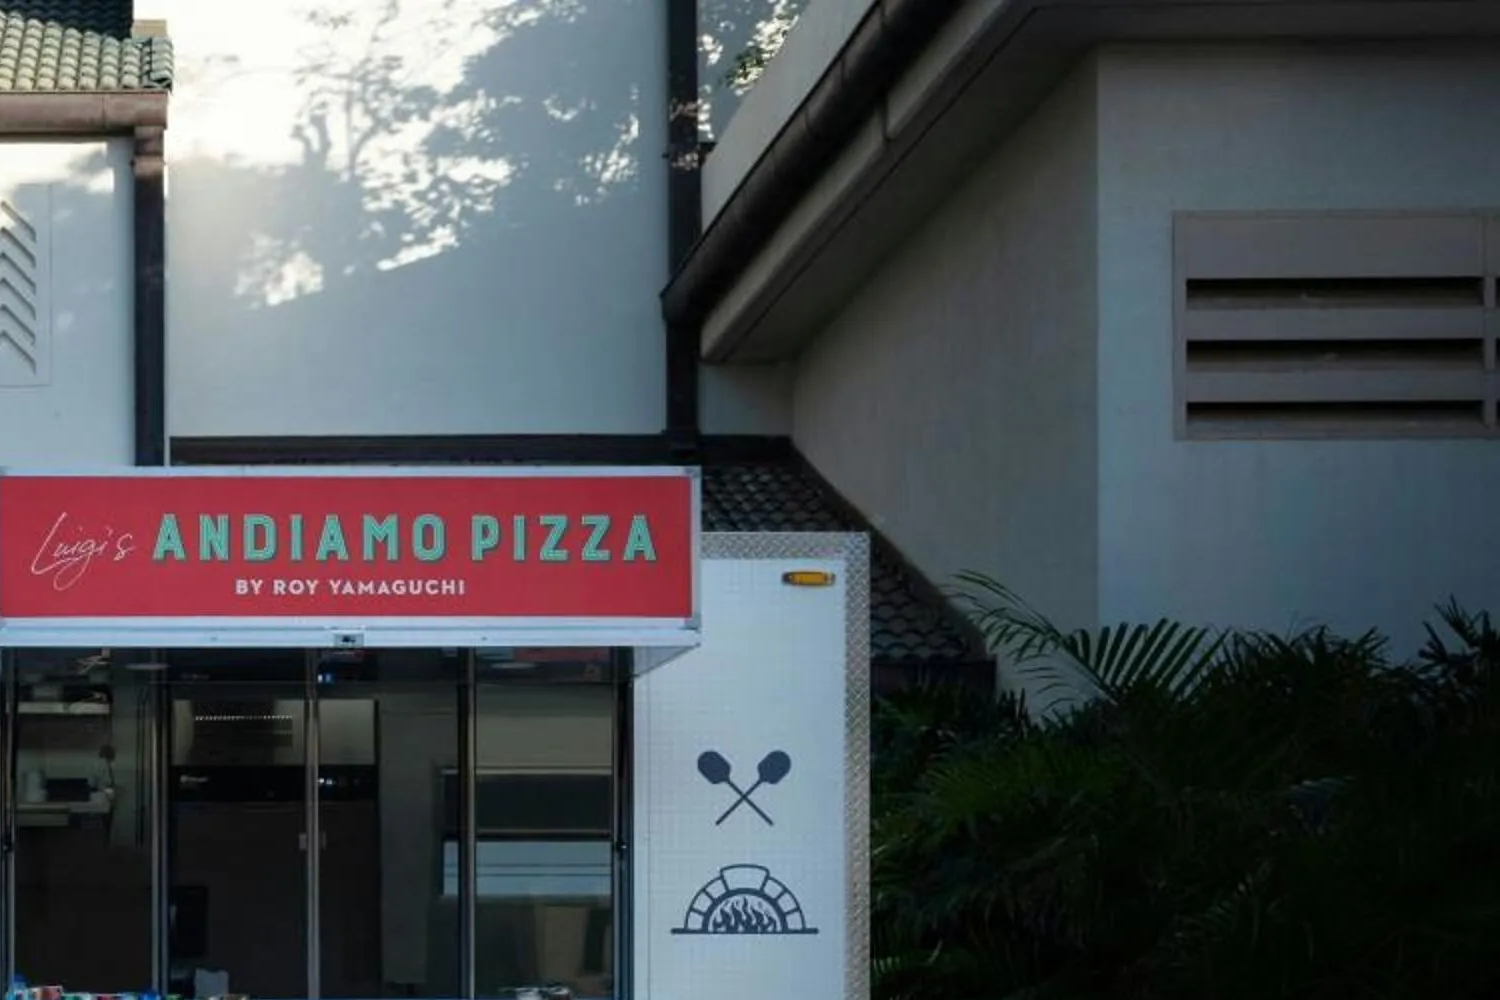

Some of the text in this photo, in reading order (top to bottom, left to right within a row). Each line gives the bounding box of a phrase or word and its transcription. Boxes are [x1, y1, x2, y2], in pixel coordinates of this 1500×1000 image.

[31, 511, 657, 591] Luigi's ANDIAMO PIZZA
[235, 579, 466, 596] BY ROY YAMAGUCHI
